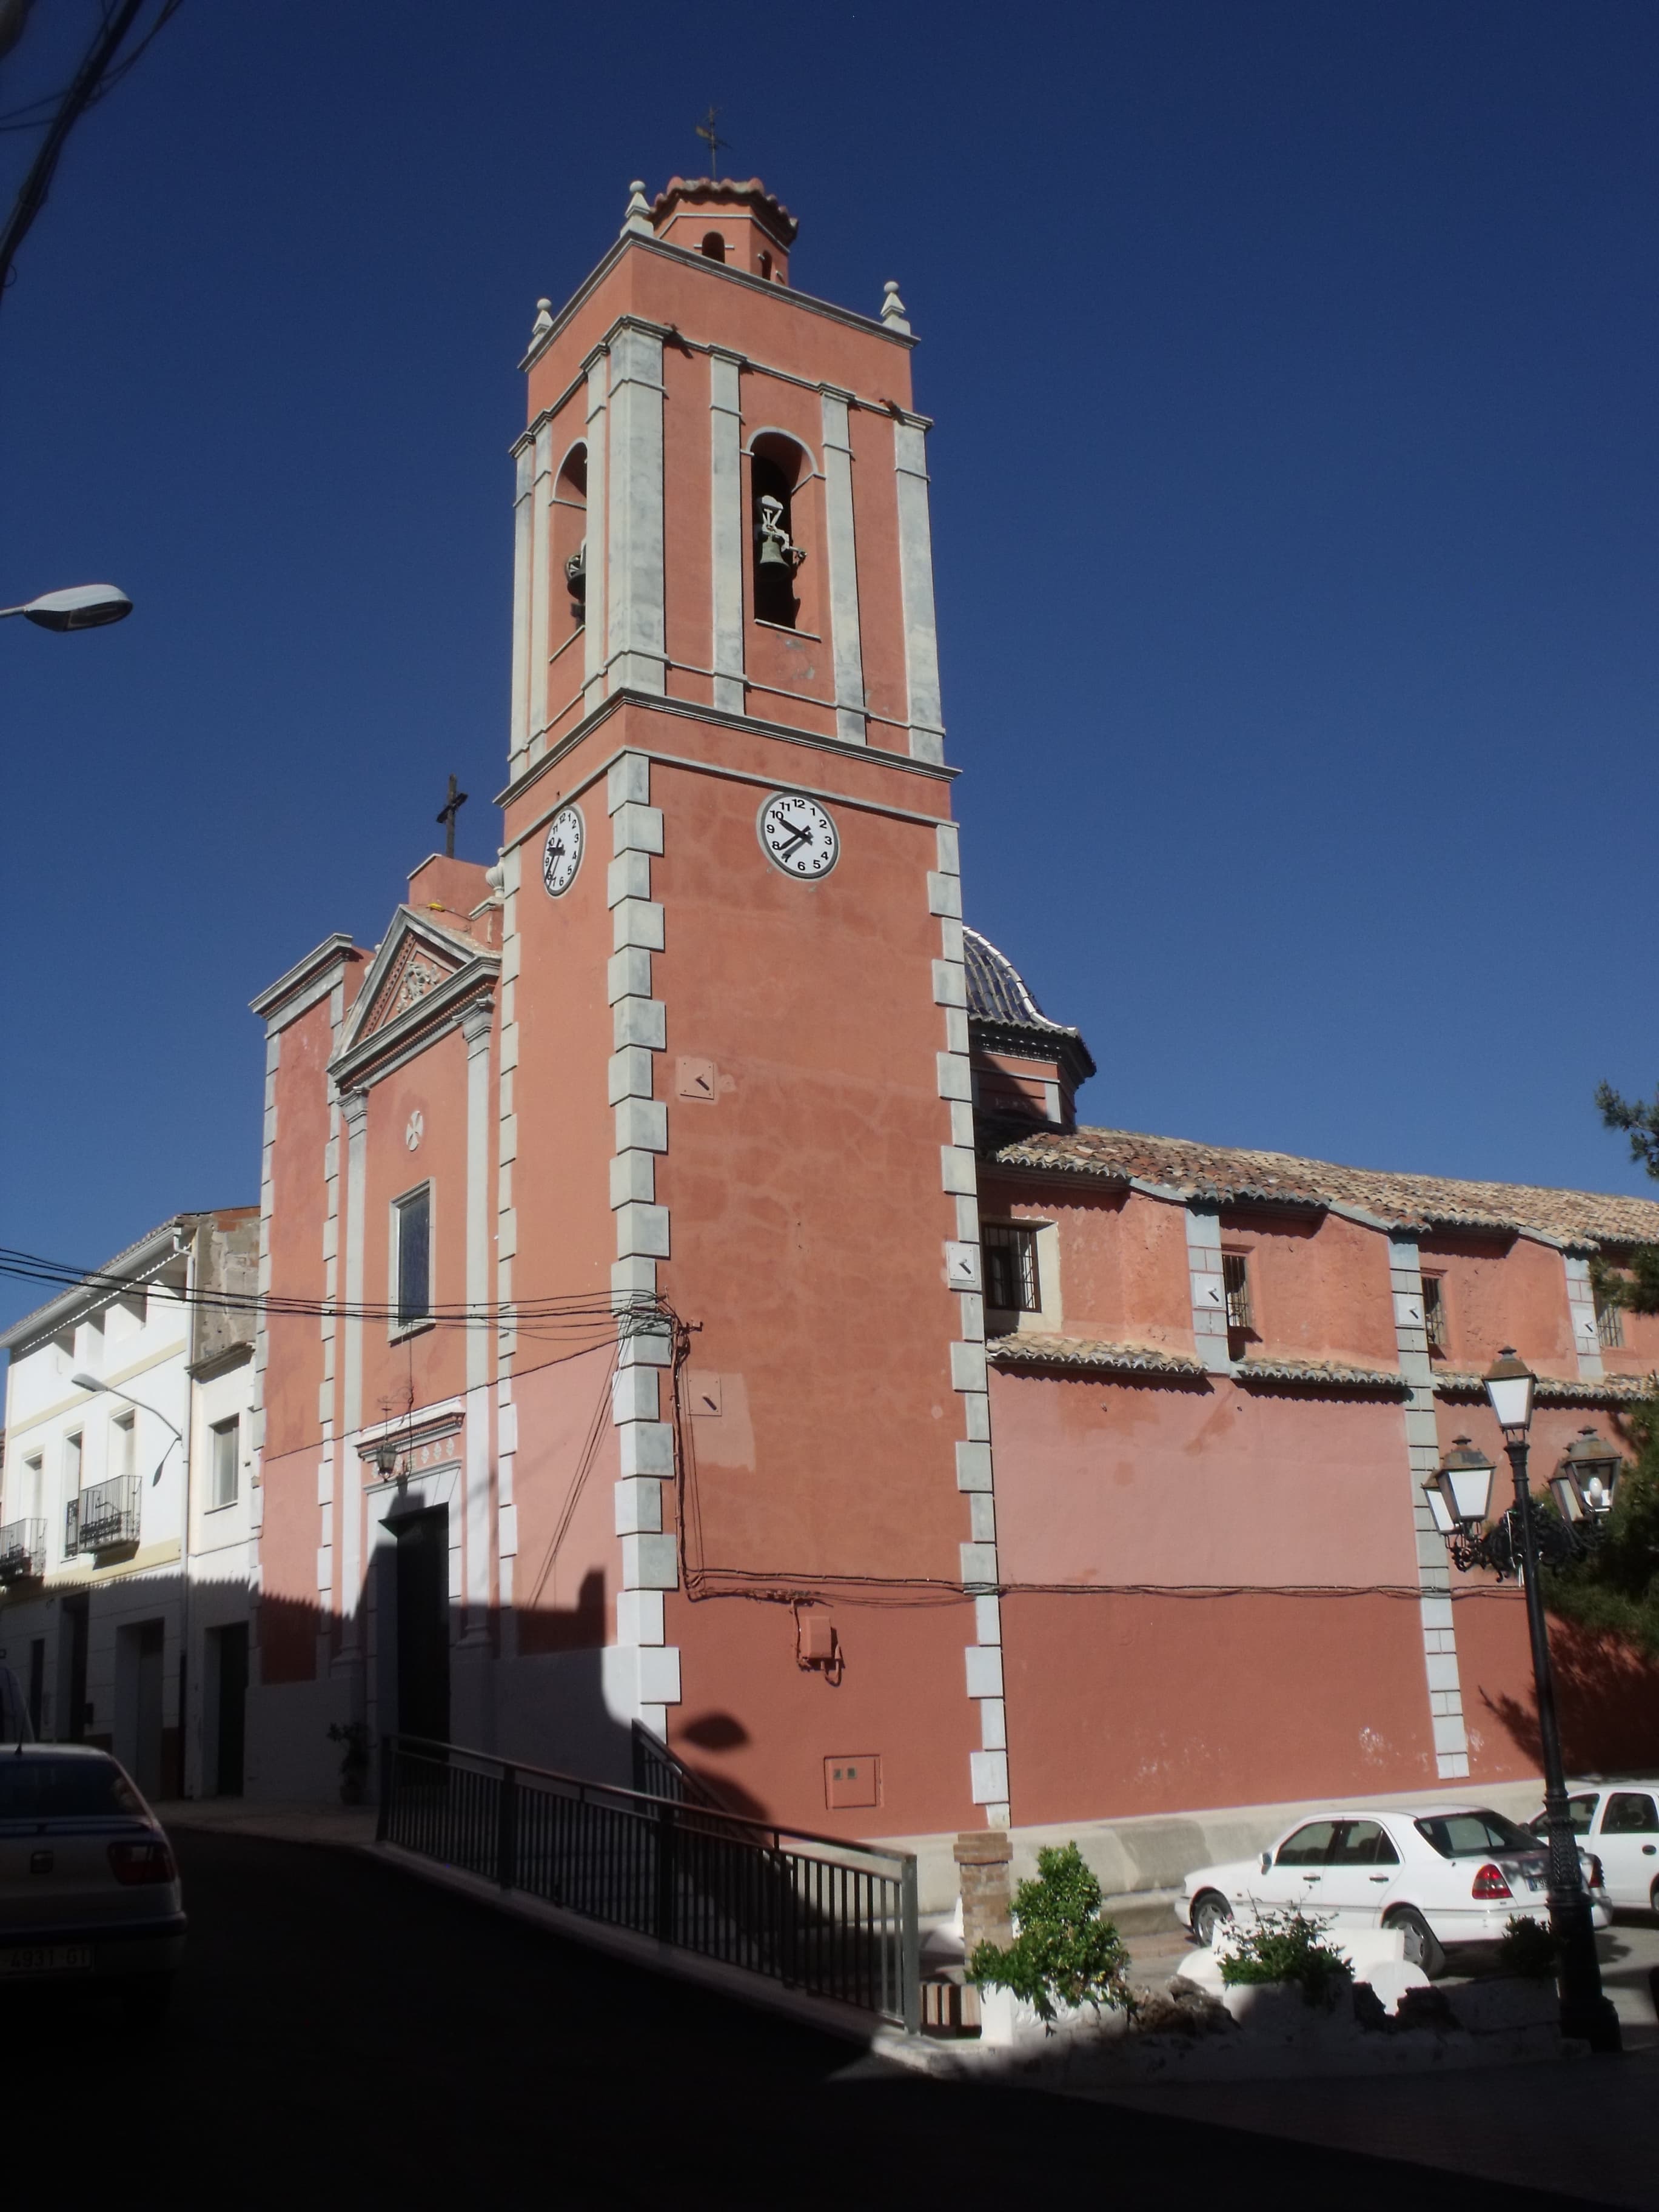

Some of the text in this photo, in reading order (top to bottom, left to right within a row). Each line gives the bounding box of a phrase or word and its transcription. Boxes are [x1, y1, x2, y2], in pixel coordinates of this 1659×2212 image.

[780, 802, 790, 811] 11
[792, 799, 805, 809] 12
[560, 813, 566, 824] 12
[770, 810, 783, 820] 10
[572, 820, 576, 829] 2
[819, 820, 827, 828] 2
[553, 824, 558, 834] 11
[766, 825, 774, 833] 9
[574, 834, 578, 843] 3
[825, 836, 832, 845] 3
[572, 851, 577, 860] 4
[783, 854, 791, 862] 7
[545, 857, 549, 866] 9
[798, 862, 805, 870] 6
[568, 865, 572, 874] 5
[559, 877, 564, 886] 6
